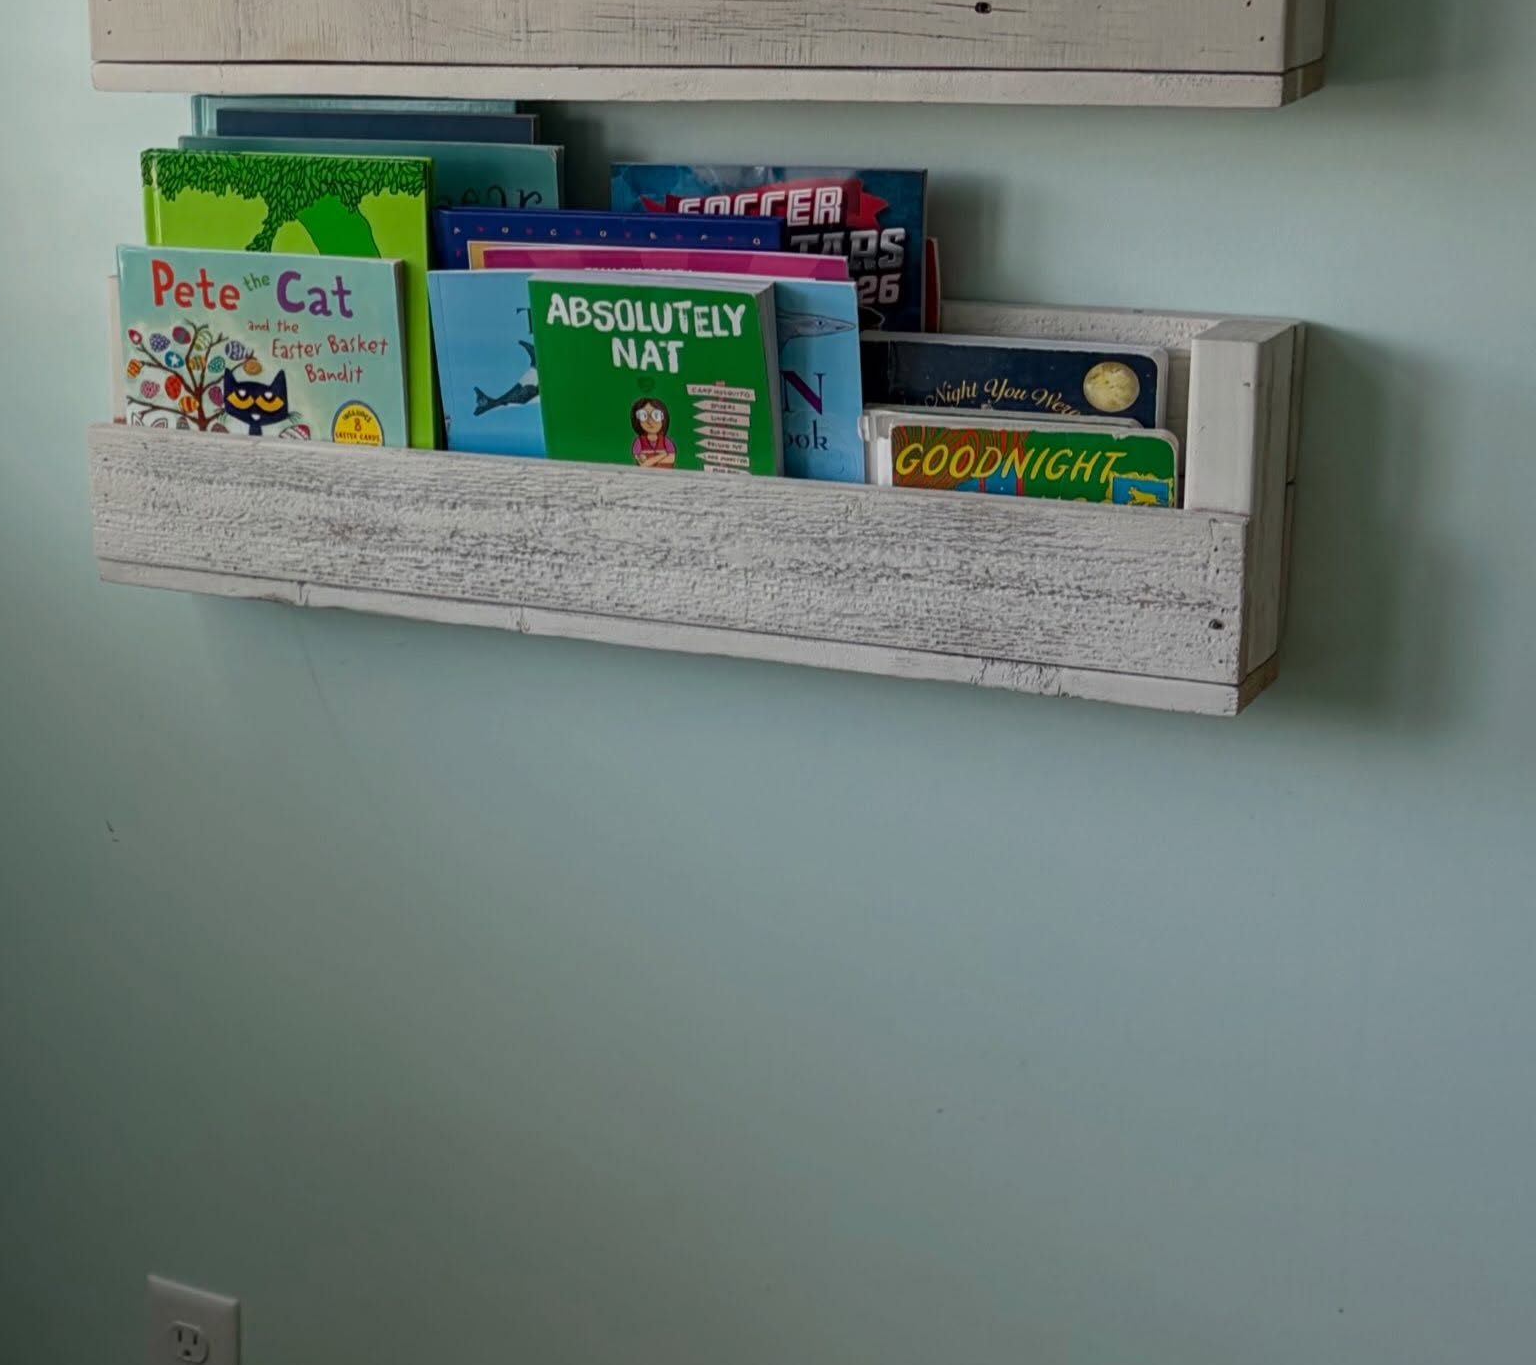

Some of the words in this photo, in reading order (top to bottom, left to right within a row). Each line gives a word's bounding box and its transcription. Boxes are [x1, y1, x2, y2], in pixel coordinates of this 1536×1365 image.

[151, 259, 240, 311] Pete
[242, 272, 271, 292] the
[276, 270, 354, 318] Cat
[247, 319, 270, 332] and
[277, 319, 299, 334] the
[546, 293, 746, 338] ABSOLUTELY
[271, 338, 322, 360] Easter
[327, 334, 389, 356] Basket
[611, 337, 684, 373] NAT
[304, 359, 364, 384] Bandit
[983, 378, 1026, 403] You
[895, 442, 1127, 485] GOODNIGHT
